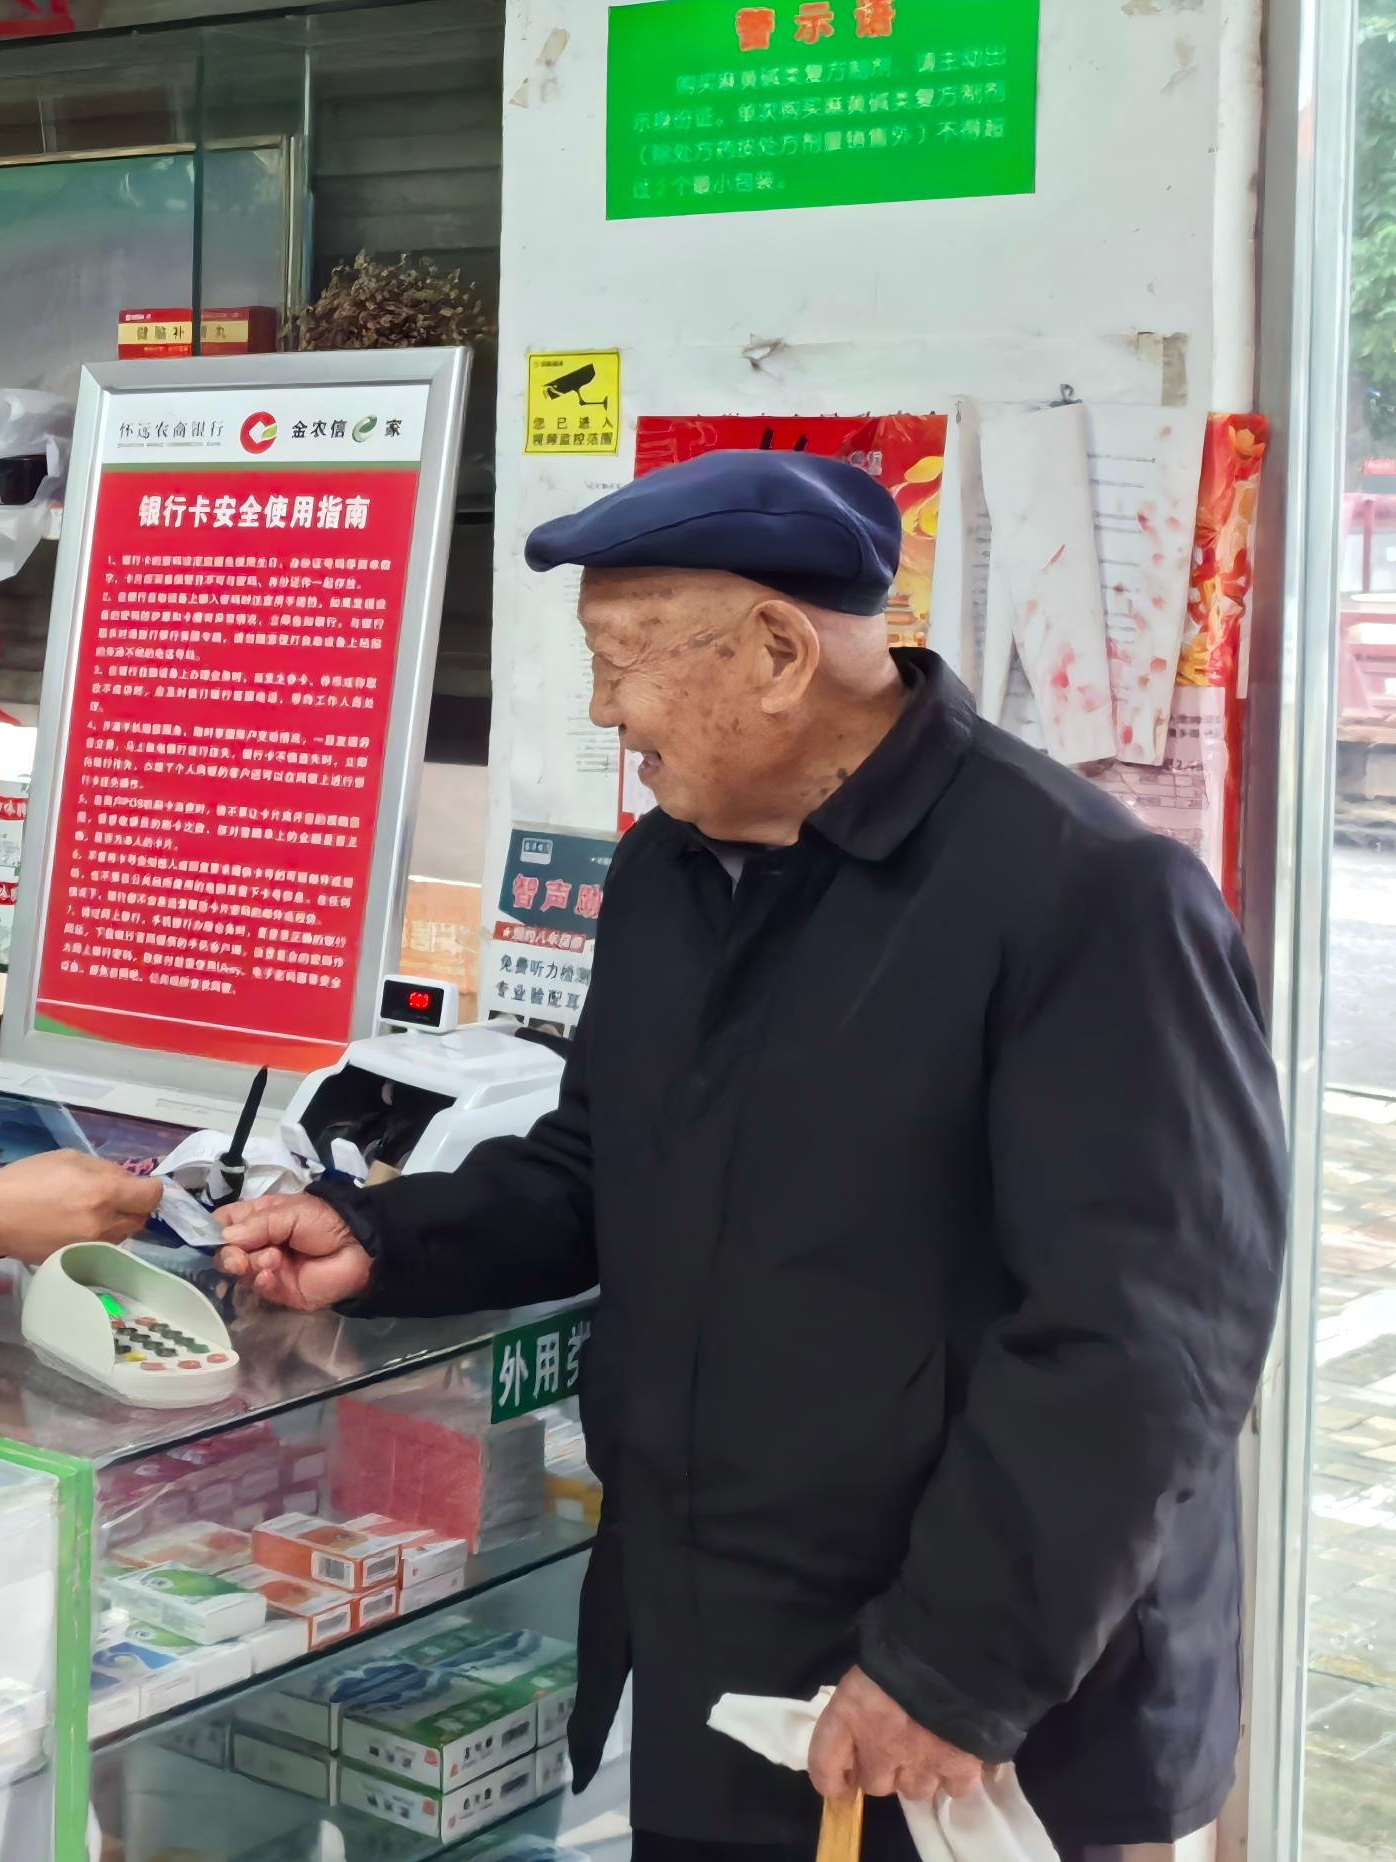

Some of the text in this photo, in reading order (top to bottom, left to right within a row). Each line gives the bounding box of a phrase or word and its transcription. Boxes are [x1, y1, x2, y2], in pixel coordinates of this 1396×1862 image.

[136, 324, 227, 341] 健脑补丸
[532, 416, 613, 430] 您已进入
[138, 494, 371, 530] 银行卡安全使用指南
